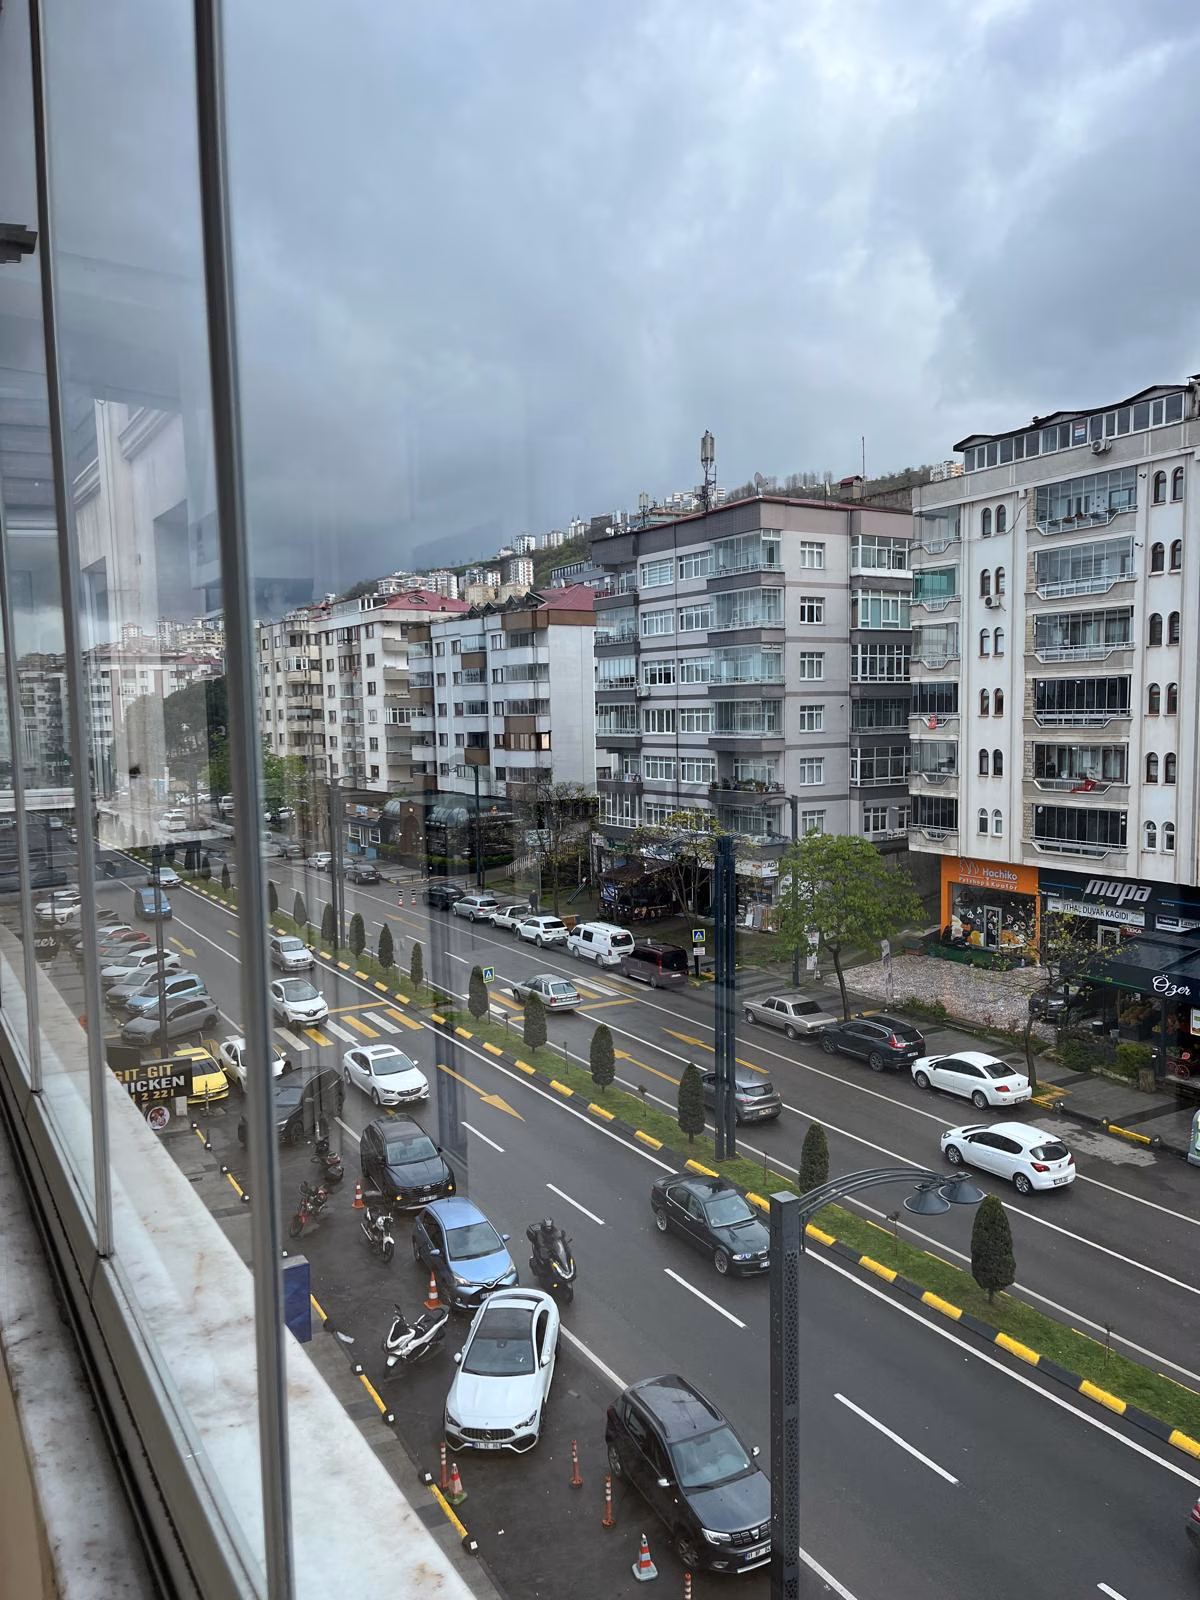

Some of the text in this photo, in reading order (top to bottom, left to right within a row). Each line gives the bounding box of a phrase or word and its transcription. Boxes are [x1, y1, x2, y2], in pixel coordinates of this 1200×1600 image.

[982, 867, 1018, 881] Hachiko
[1084, 879, 1152, 906] mopa
[1152, 974, 1191, 997] Özer
